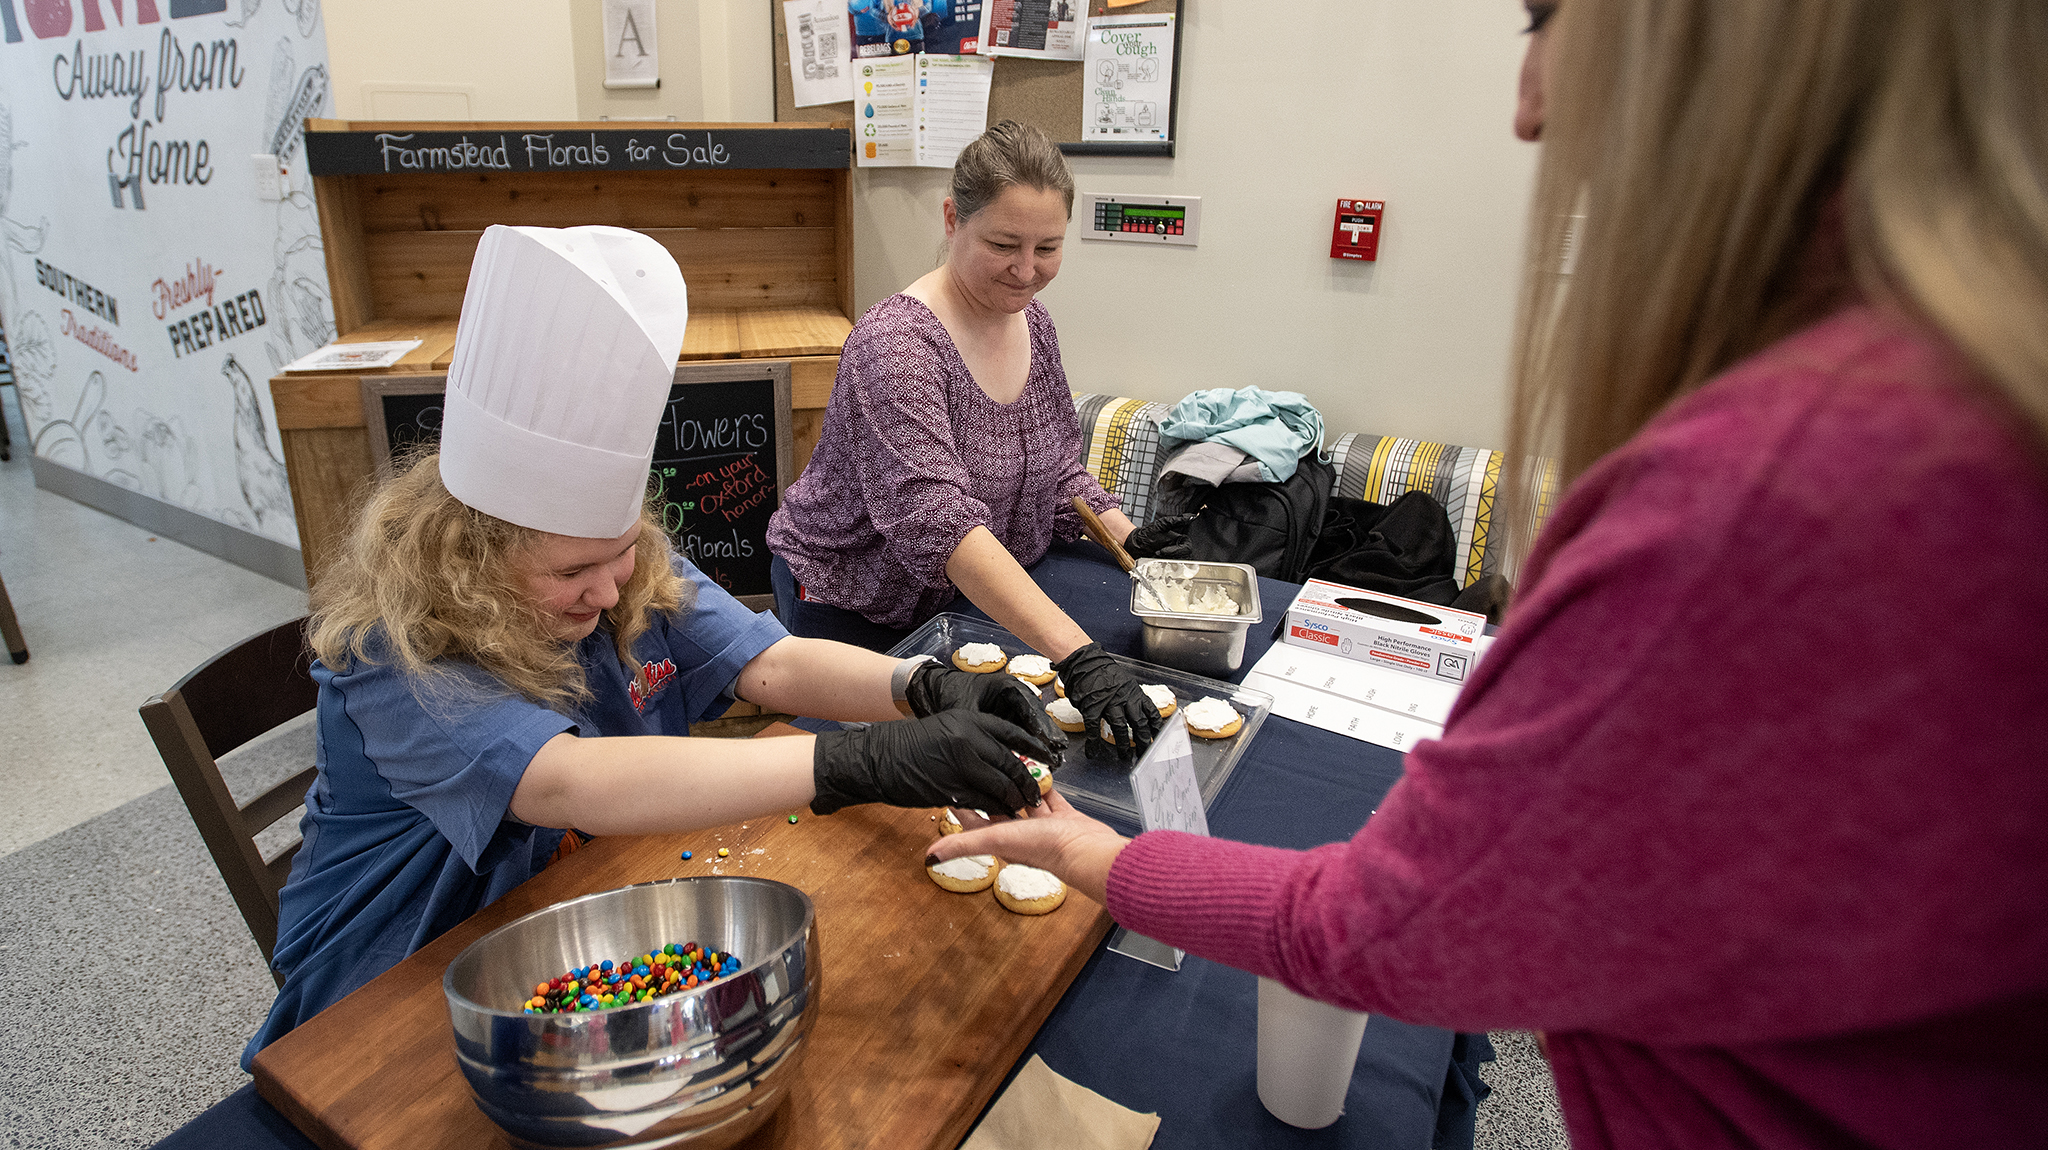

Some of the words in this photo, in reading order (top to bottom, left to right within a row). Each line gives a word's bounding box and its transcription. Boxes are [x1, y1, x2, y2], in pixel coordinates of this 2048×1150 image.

[615, 7, 649, 57] A
[1101, 29, 1141, 44] Cover
[1116, 42, 1157, 58] Cough
[53, 38, 149, 119] Away
[155, 27, 244, 122] from
[107, 120, 212, 188] Home
[375, 133, 511, 171] Farmstead
[522, 132, 610, 168] Florals
[625, 138, 656, 162] for
[662, 132, 730, 167] Sale
[1340, 200, 1351, 209] FIRE
[1364, 202, 1383, 211] ALARM
[34, 258, 120, 327] SOUTHERN
[166, 288, 267, 358] PREPARED
[60, 307, 139, 373] Traditions
[719, 453, 754, 484] your
[700, 464, 770, 514] Oxford
[1304, 618, 1329, 632] Sysco
[1298, 628, 1331, 644] Classic
[1377, 635, 1392, 643] High
[1393, 638, 1431, 652] Performance
[1373, 640, 1389, 648] Black
[1390, 644, 1409, 653] Nitrile
[1410, 648, 1431, 658] Gloves
[1305, 705, 1318, 719] HOPE
[1347, 717, 1360, 732] FAITH
[1392, 731, 1404, 745] LOVE
